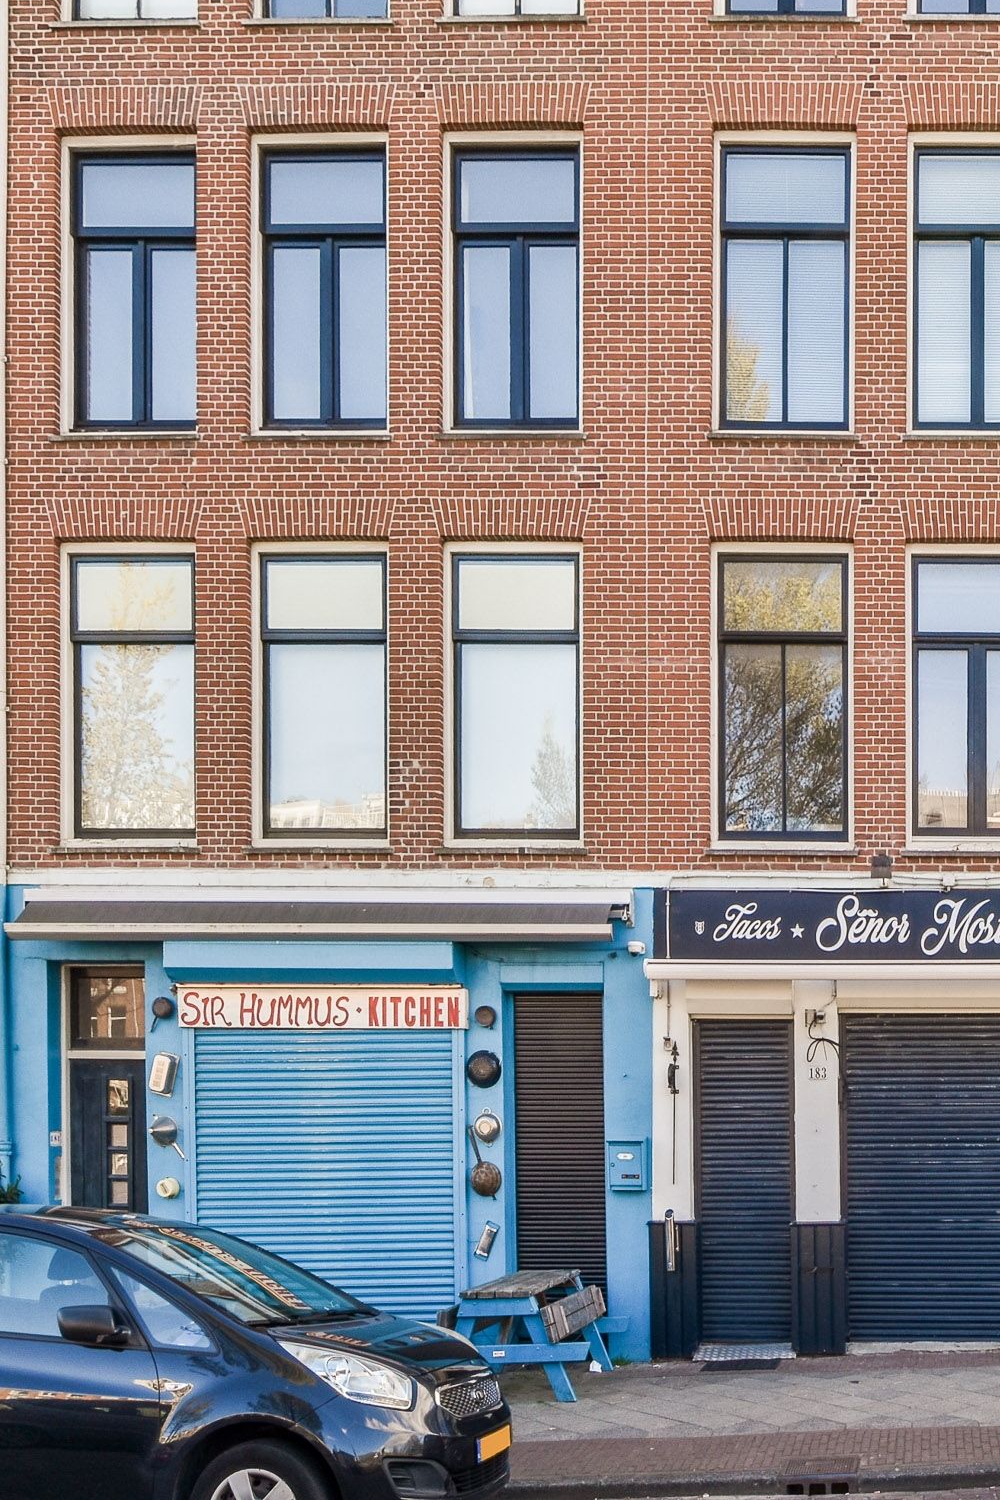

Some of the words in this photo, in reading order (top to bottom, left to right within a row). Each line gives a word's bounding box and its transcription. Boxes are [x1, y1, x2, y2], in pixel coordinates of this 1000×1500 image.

[713, 902, 782, 942] Tacos
[815, 894, 911, 952] Señor
[180, 991, 232, 1026] SIR
[239, 992, 350, 1027] HUMMUS
[368, 996, 460, 1027] KITCHEN
[809, 1066, 827, 1079] 183
